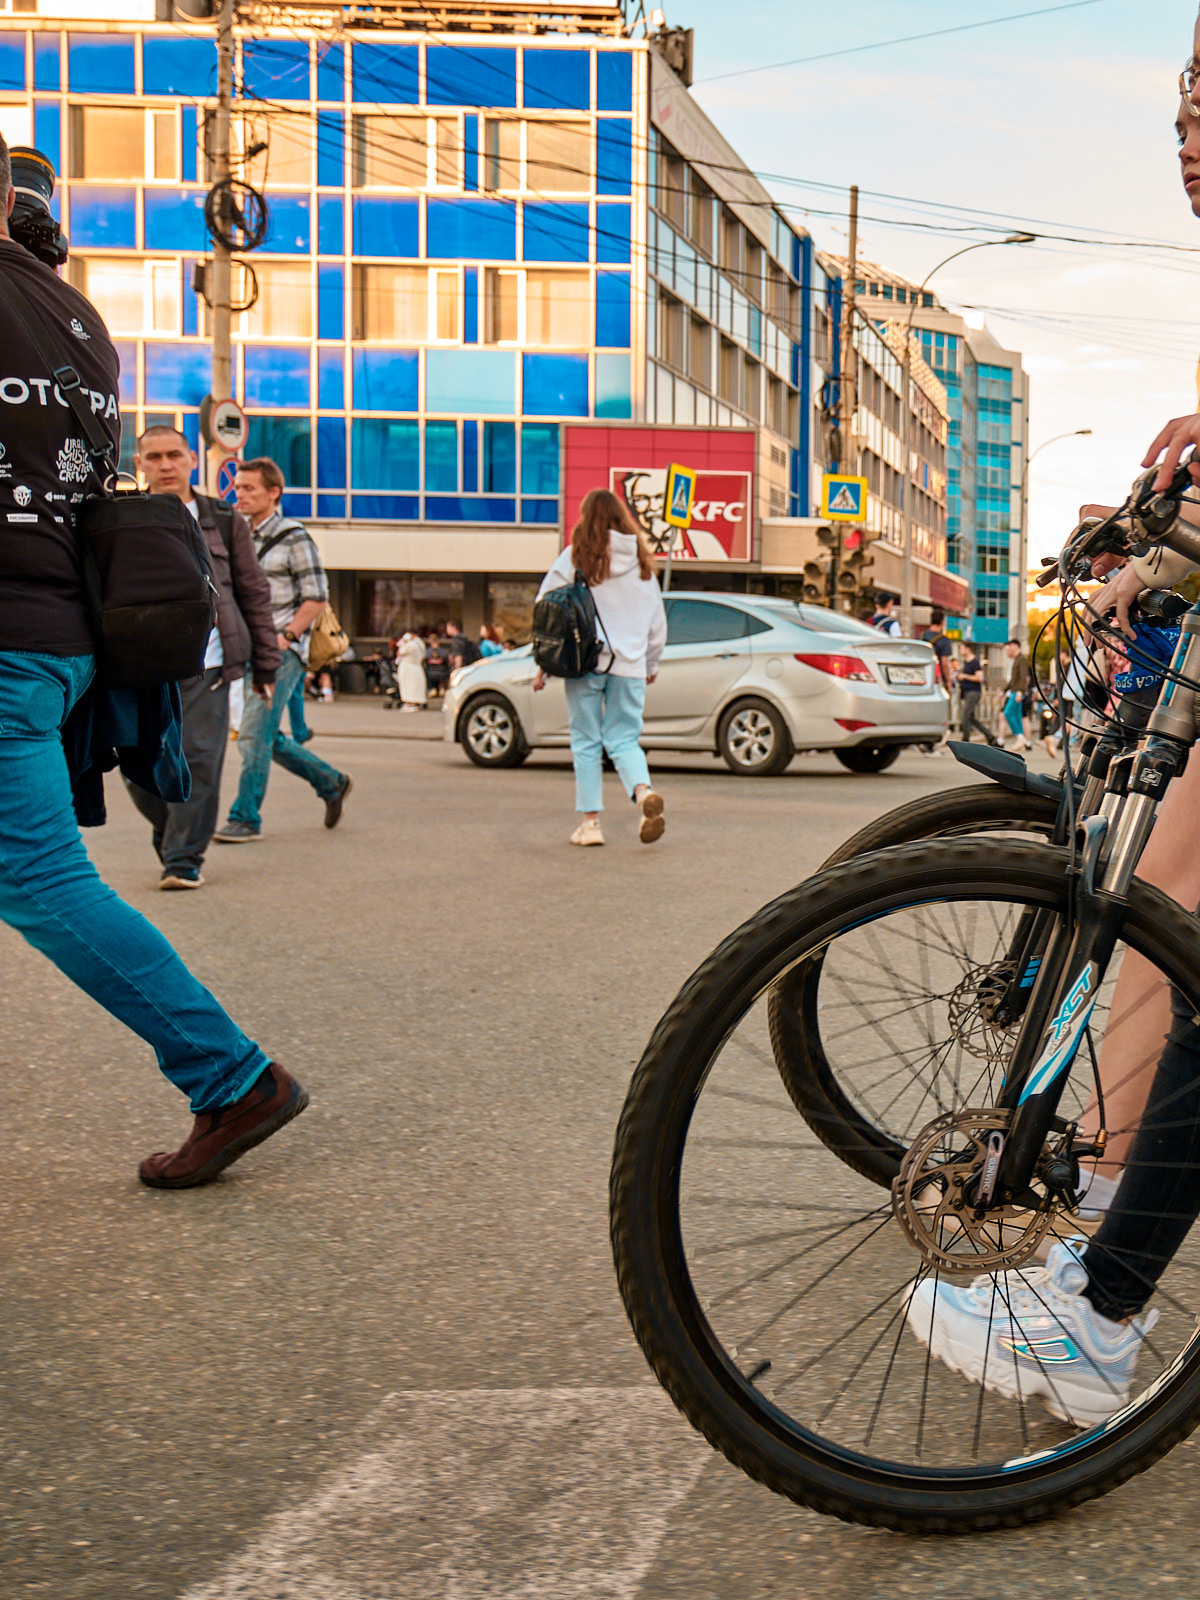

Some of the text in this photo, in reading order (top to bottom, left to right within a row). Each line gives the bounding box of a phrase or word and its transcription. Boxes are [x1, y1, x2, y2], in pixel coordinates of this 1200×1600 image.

[0, 377, 118, 420] ОТРА
[59, 469, 88, 483] CREW
[690, 500, 745, 522] KFC
[1050, 963, 1092, 1040] XCT
